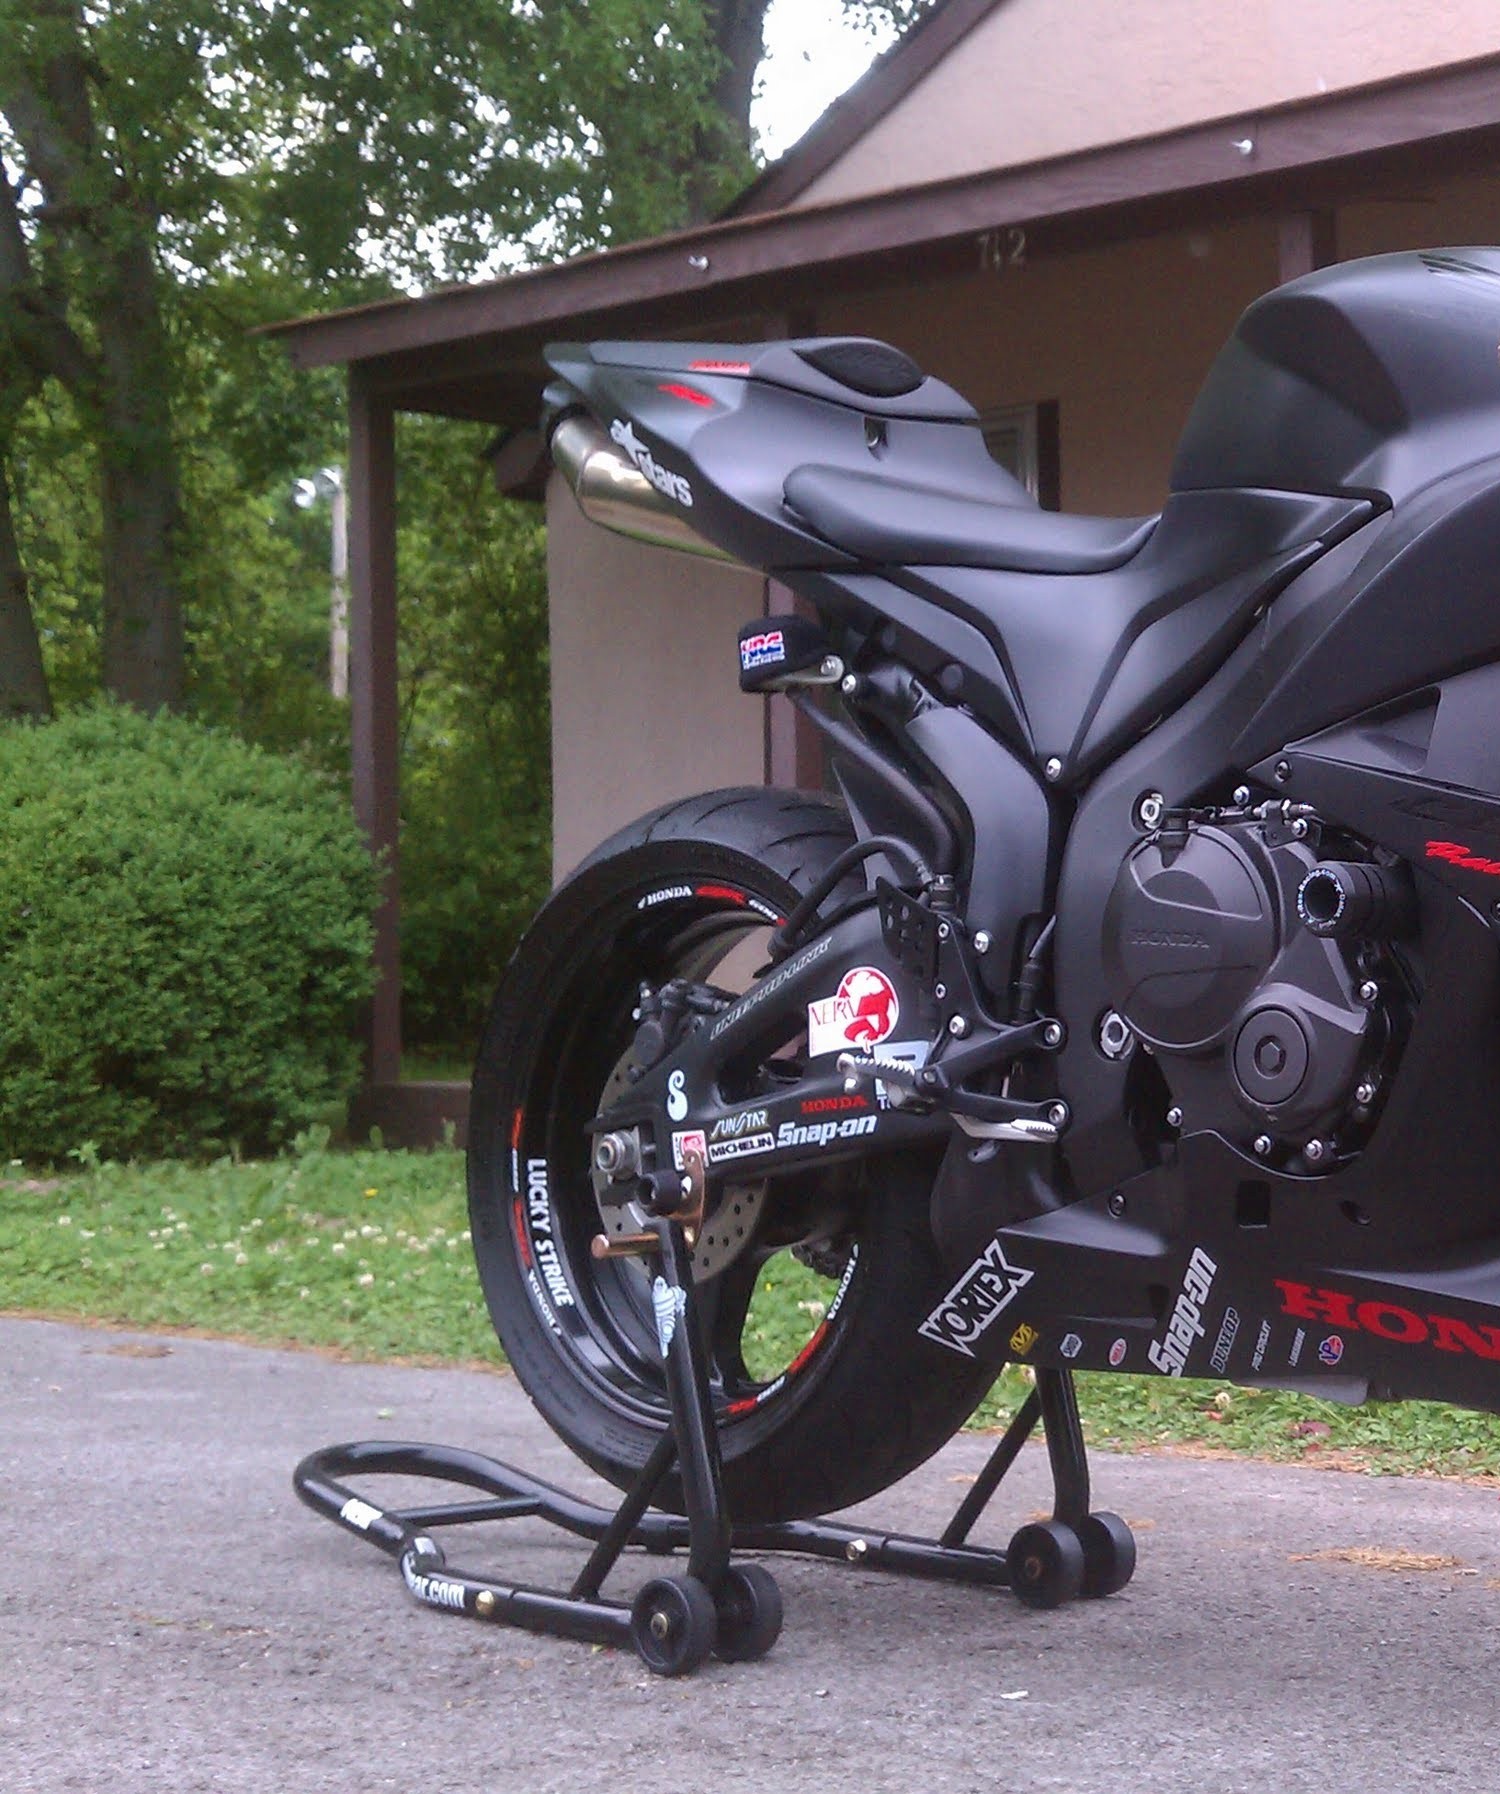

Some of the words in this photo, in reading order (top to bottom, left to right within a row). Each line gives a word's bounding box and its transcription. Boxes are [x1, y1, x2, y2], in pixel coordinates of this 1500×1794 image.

[646, 885, 693, 905] HONDA
[1128, 929, 1210, 949] HONDA
[811, 997, 864, 1027] NERV
[801, 1093, 867, 1115] HONDA
[710, 1109, 770, 1140] SUNSTAR
[776, 1114, 878, 1148] Snap-on
[711, 1135, 773, 1158] MICHELIN
[527, 1158, 551, 1233] LUCKY
[535, 1239, 574, 1307] STRIKE
[918, 1239, 1035, 1357] VORTEX
[1148, 1247, 1218, 1377] Snap-on
[1209, 1306, 1241, 1374] DUNLOP
